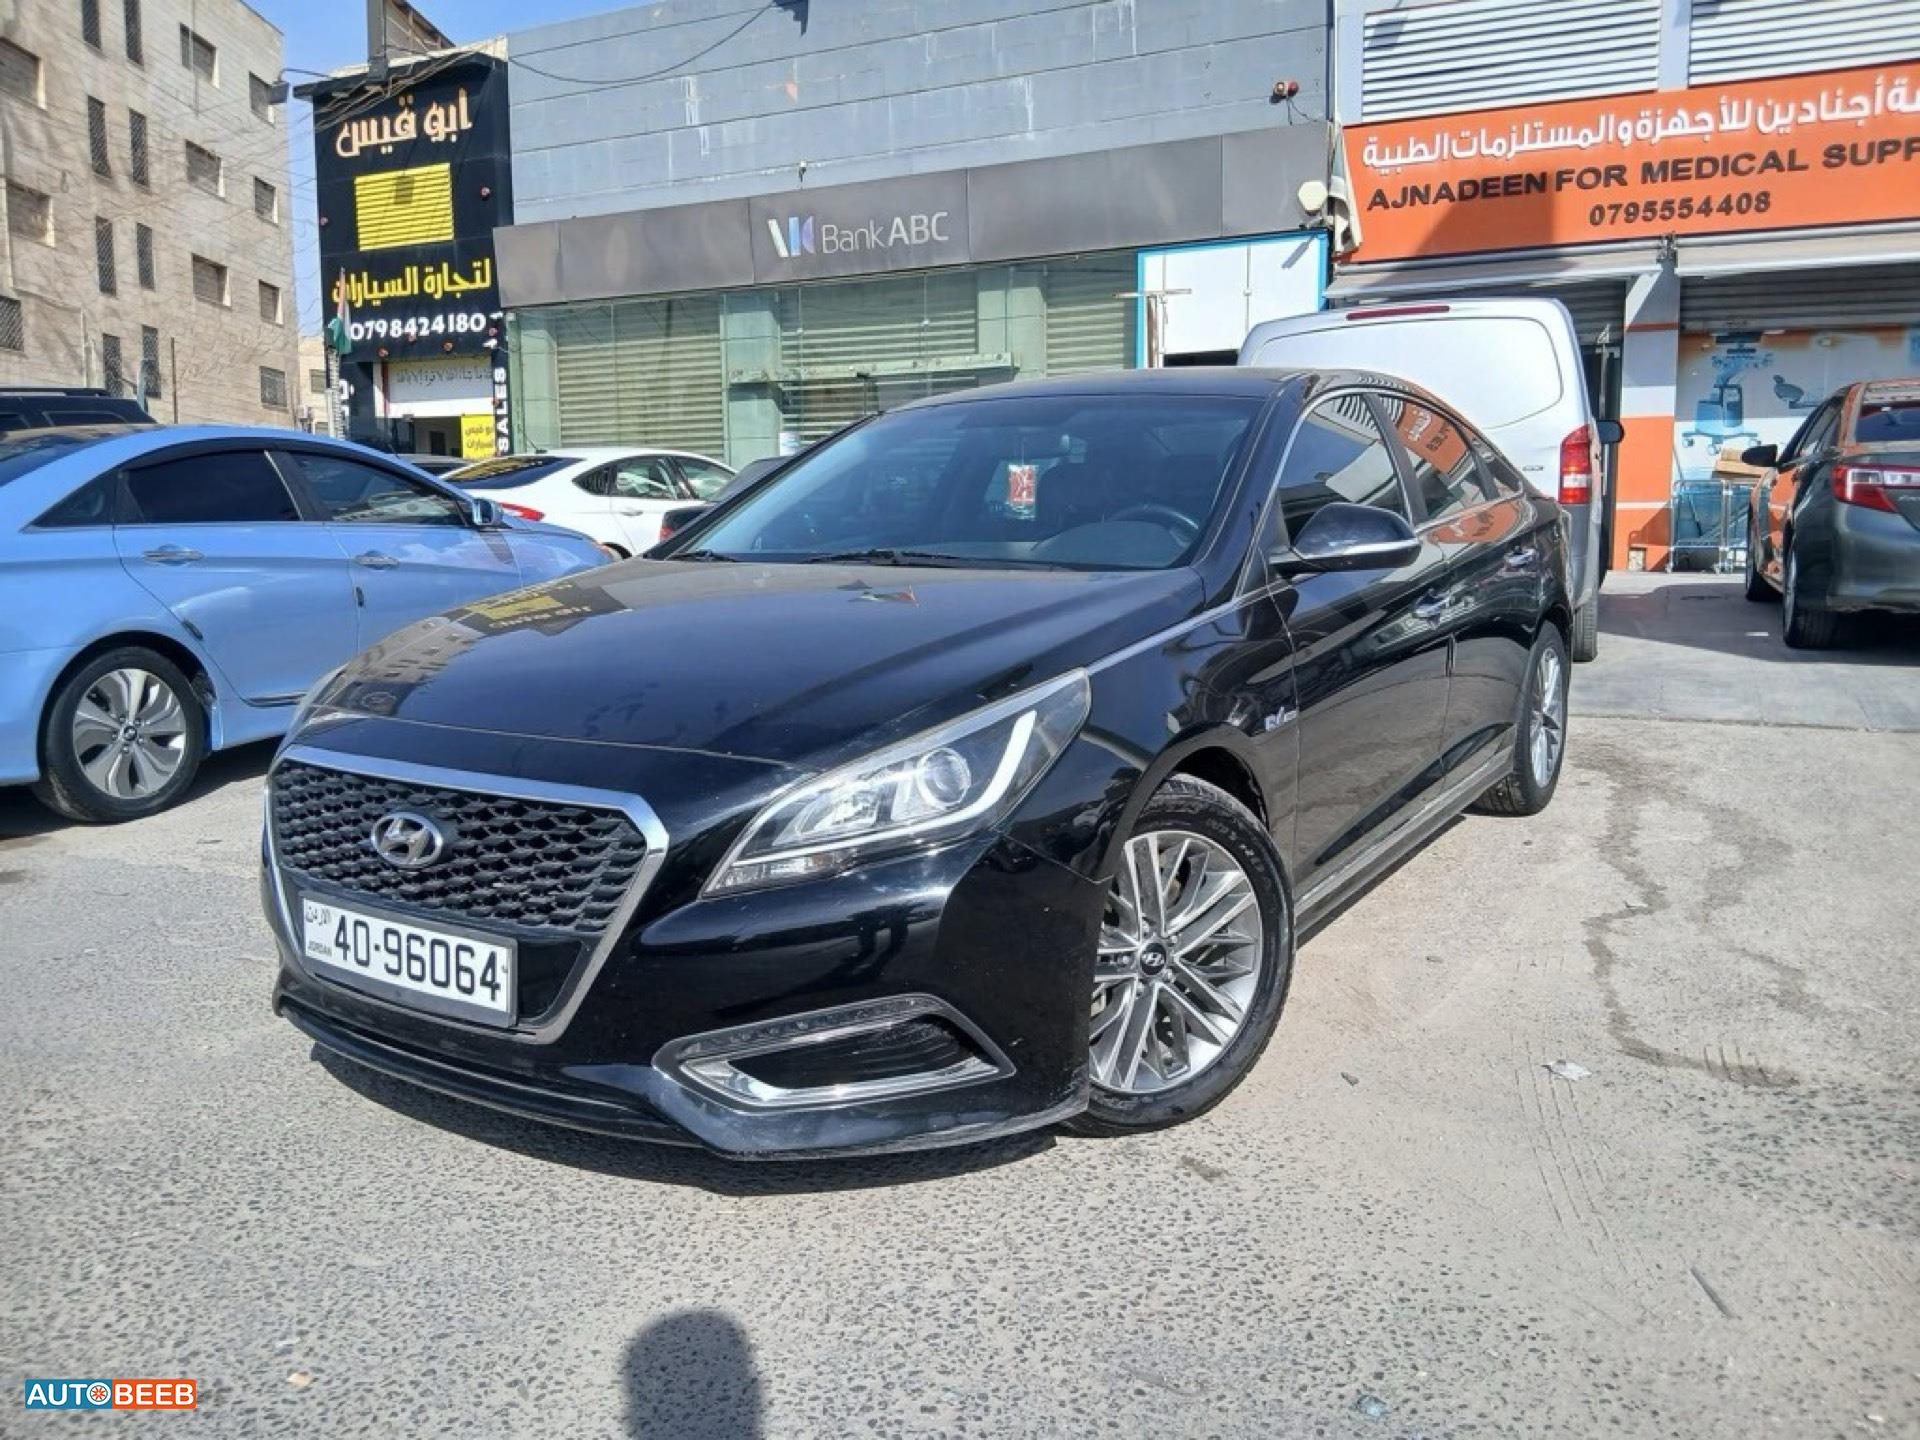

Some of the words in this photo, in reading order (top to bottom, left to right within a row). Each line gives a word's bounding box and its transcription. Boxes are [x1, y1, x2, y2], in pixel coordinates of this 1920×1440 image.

[335, 94, 418, 158] قيس
[423, 87, 473, 142] ابو
[1635, 94, 1753, 144] للأجهزة
[1755, 73, 1884, 135] أجنادين
[1362, 131, 1449, 176] الطبية
[1366, 171, 1548, 211] AJNADEEN
[1555, 164, 1628, 191] FOR
[1640, 148, 1809, 185] MEDICAL
[887, 211, 949, 248] ABC
[1589, 190, 1771, 226] 0795554408
[423, 257, 493, 300] لتجارة
[349, 312, 487, 341] 0798424180
[493, 366, 509, 453] SALES
